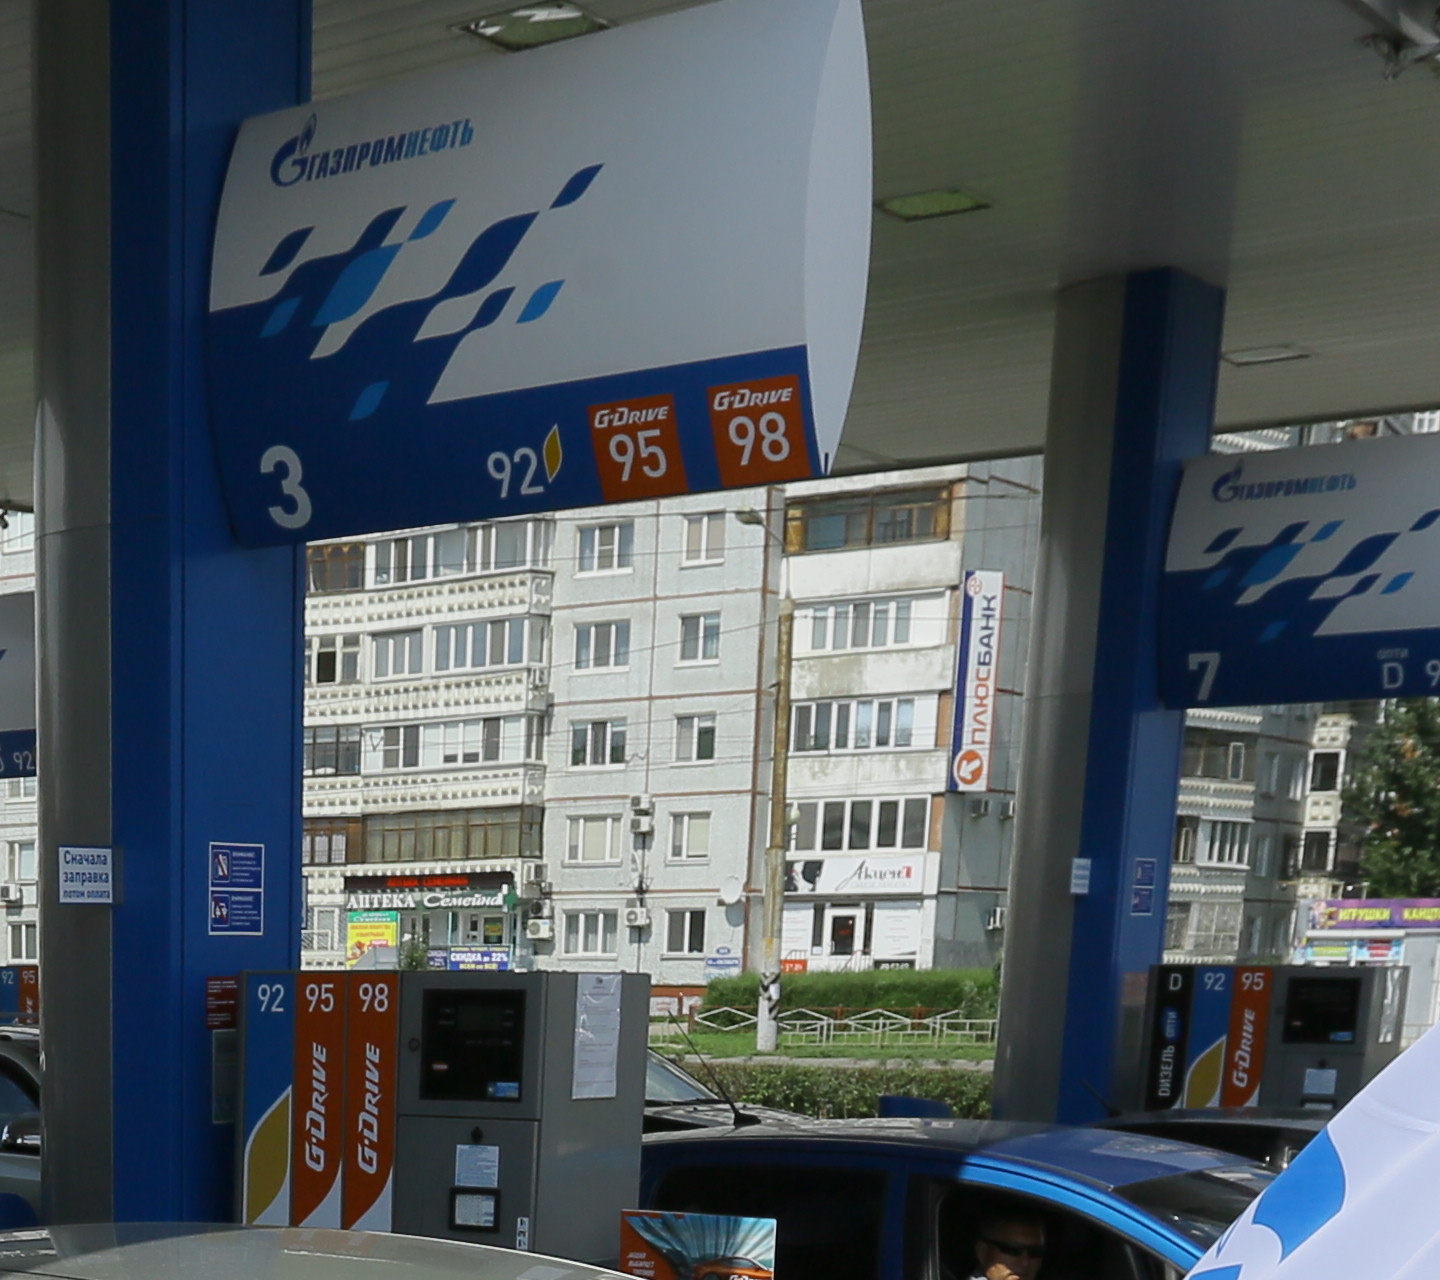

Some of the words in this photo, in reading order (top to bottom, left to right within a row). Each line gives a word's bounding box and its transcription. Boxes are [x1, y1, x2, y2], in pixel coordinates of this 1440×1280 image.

[306, 118, 474, 181] ГАЗПРОМНЕФТЬ
[728, 411, 791, 467] 98
[609, 428, 668, 482] 95
[486, 447, 545, 498] 92
[1235, 473, 1357, 500] ГАЗПРОМНЕФТЬ
[260, 445, 312, 529] 3
[971, 594, 998, 745] ПЛЮСБАНК
[1188, 651, 1221, 702] 7
[1382, 662, 1405, 691] D
[13, 750, 35, 771] 92
[63, 850, 108, 866] Сначала
[63, 870, 110, 886] заправка
[346, 892, 417, 909] АПТЕКА
[1338, 907, 1392, 921] ИГРУШКИ
[450, 952, 482, 963] СКИДКА
[491, 952, 508, 963] 22%
[1, 971, 15, 985] 92
[1170, 973, 1183, 990] D
[1204, 972, 1226, 991] 92
[1241, 972, 1265, 991] 95
[258, 984, 285, 1012] 92
[305, 983, 335, 1012] 95
[359, 983, 389, 1012] 98
